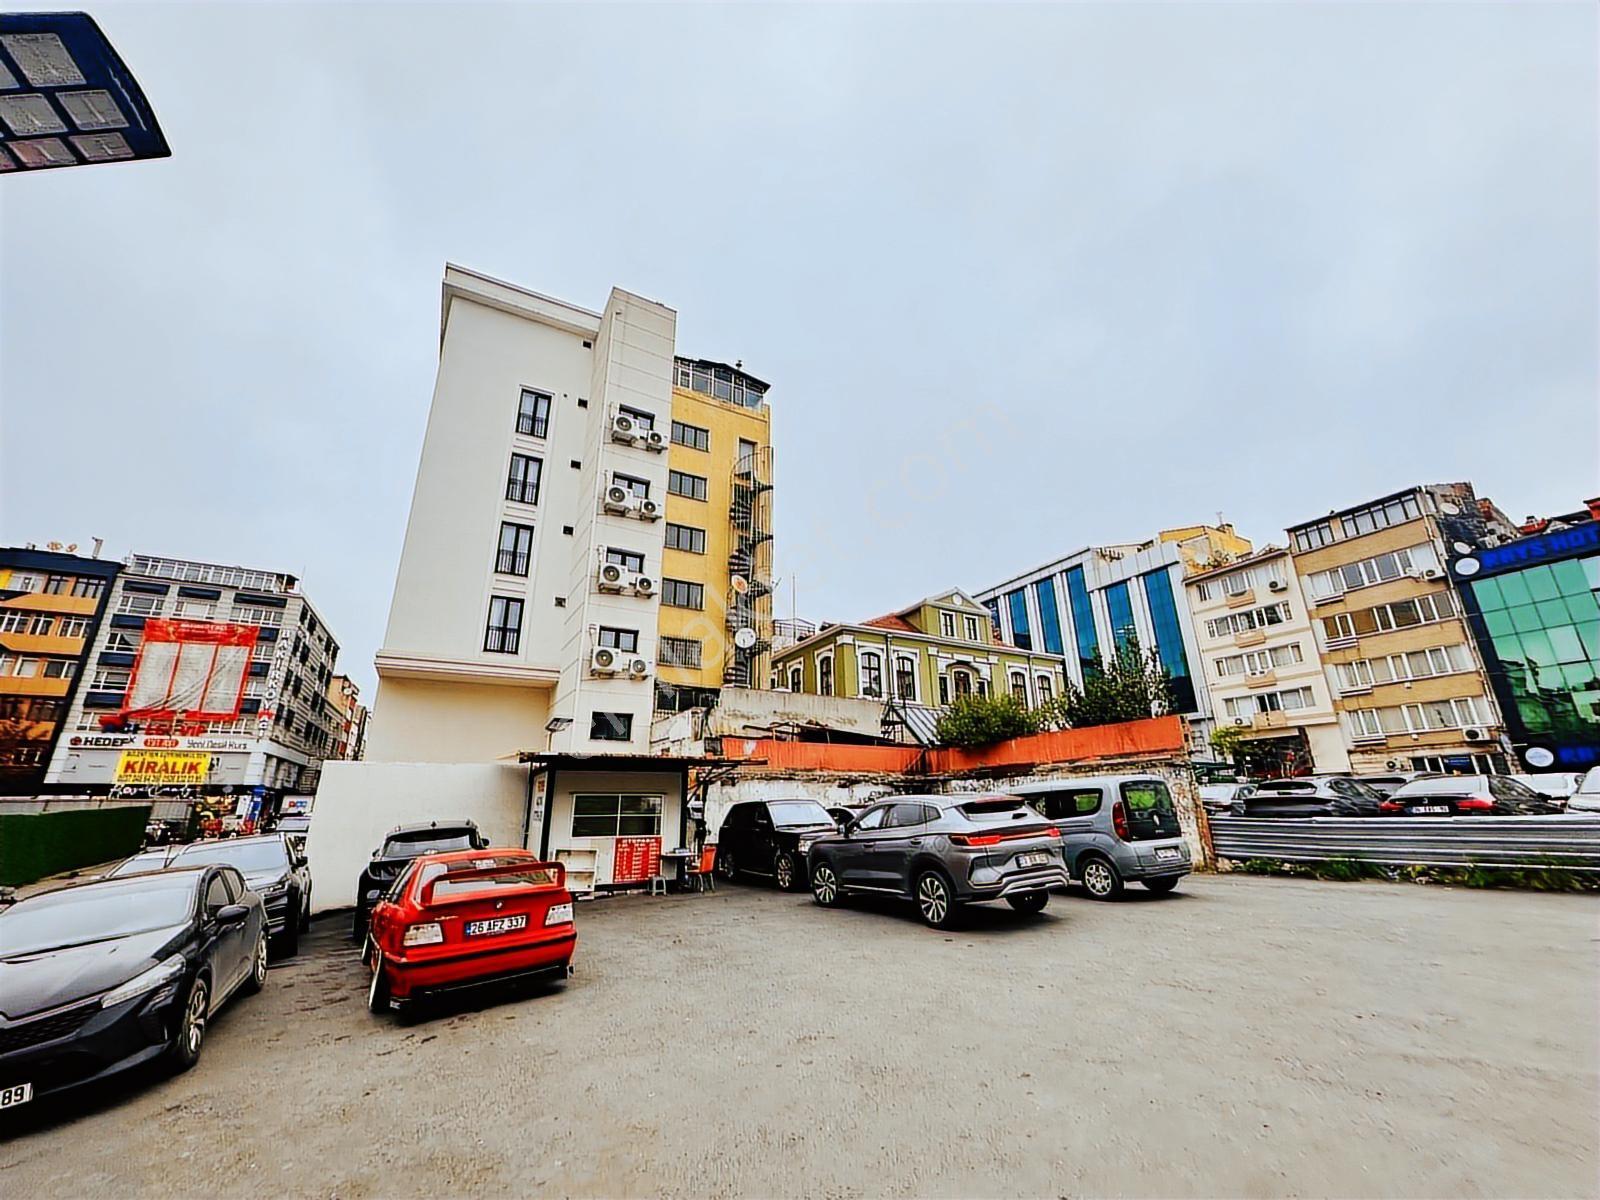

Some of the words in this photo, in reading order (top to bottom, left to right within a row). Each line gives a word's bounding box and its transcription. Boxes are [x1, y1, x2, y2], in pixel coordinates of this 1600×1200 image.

[123, 758, 202, 774] KİRALIK
[471, 923, 484, 934] 26
[486, 919, 505, 931] AFZ
[507, 917, 525, 928] 337
[1, 1086, 25, 1106] 89
